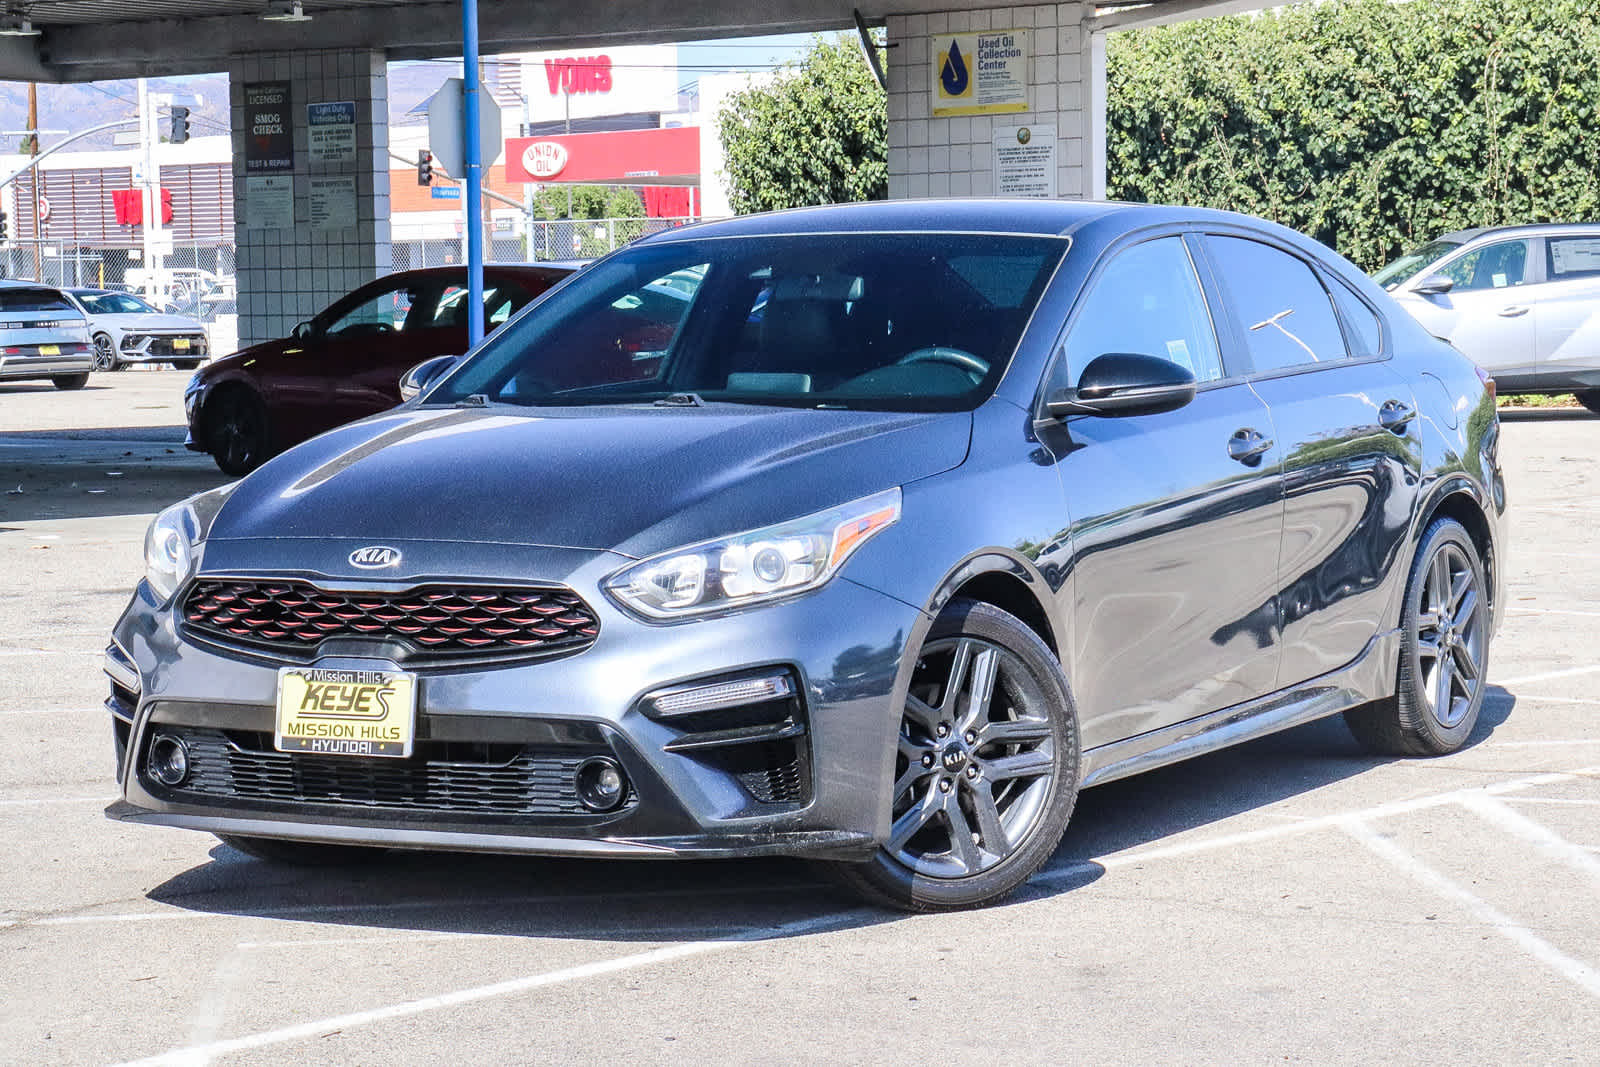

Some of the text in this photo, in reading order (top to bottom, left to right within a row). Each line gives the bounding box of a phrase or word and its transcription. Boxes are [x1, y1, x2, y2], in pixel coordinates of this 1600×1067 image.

[978, 35, 1014, 48] Used Oil
[977, 48, 1021, 59] Collection
[978, 60, 1006, 70] Center
[544, 55, 612, 95] VONS
[249, 95, 283, 105] LICENSED
[255, 113, 281, 124] SMOG
[252, 124, 283, 135] CHECK
[527, 144, 561, 161] UNION
[248, 160, 263, 168] TEST
[269, 159, 291, 168] REPAIR
[536, 160, 552, 172] OIL
[355, 549, 391, 563] KIA
[313, 670, 382, 685] Mission Hills
[297, 683, 396, 722] KEYES
[287, 722, 400, 740] MISSION HILLS
[312, 739, 372, 754] HYUNDAI
[945, 750, 966, 765] KIA
